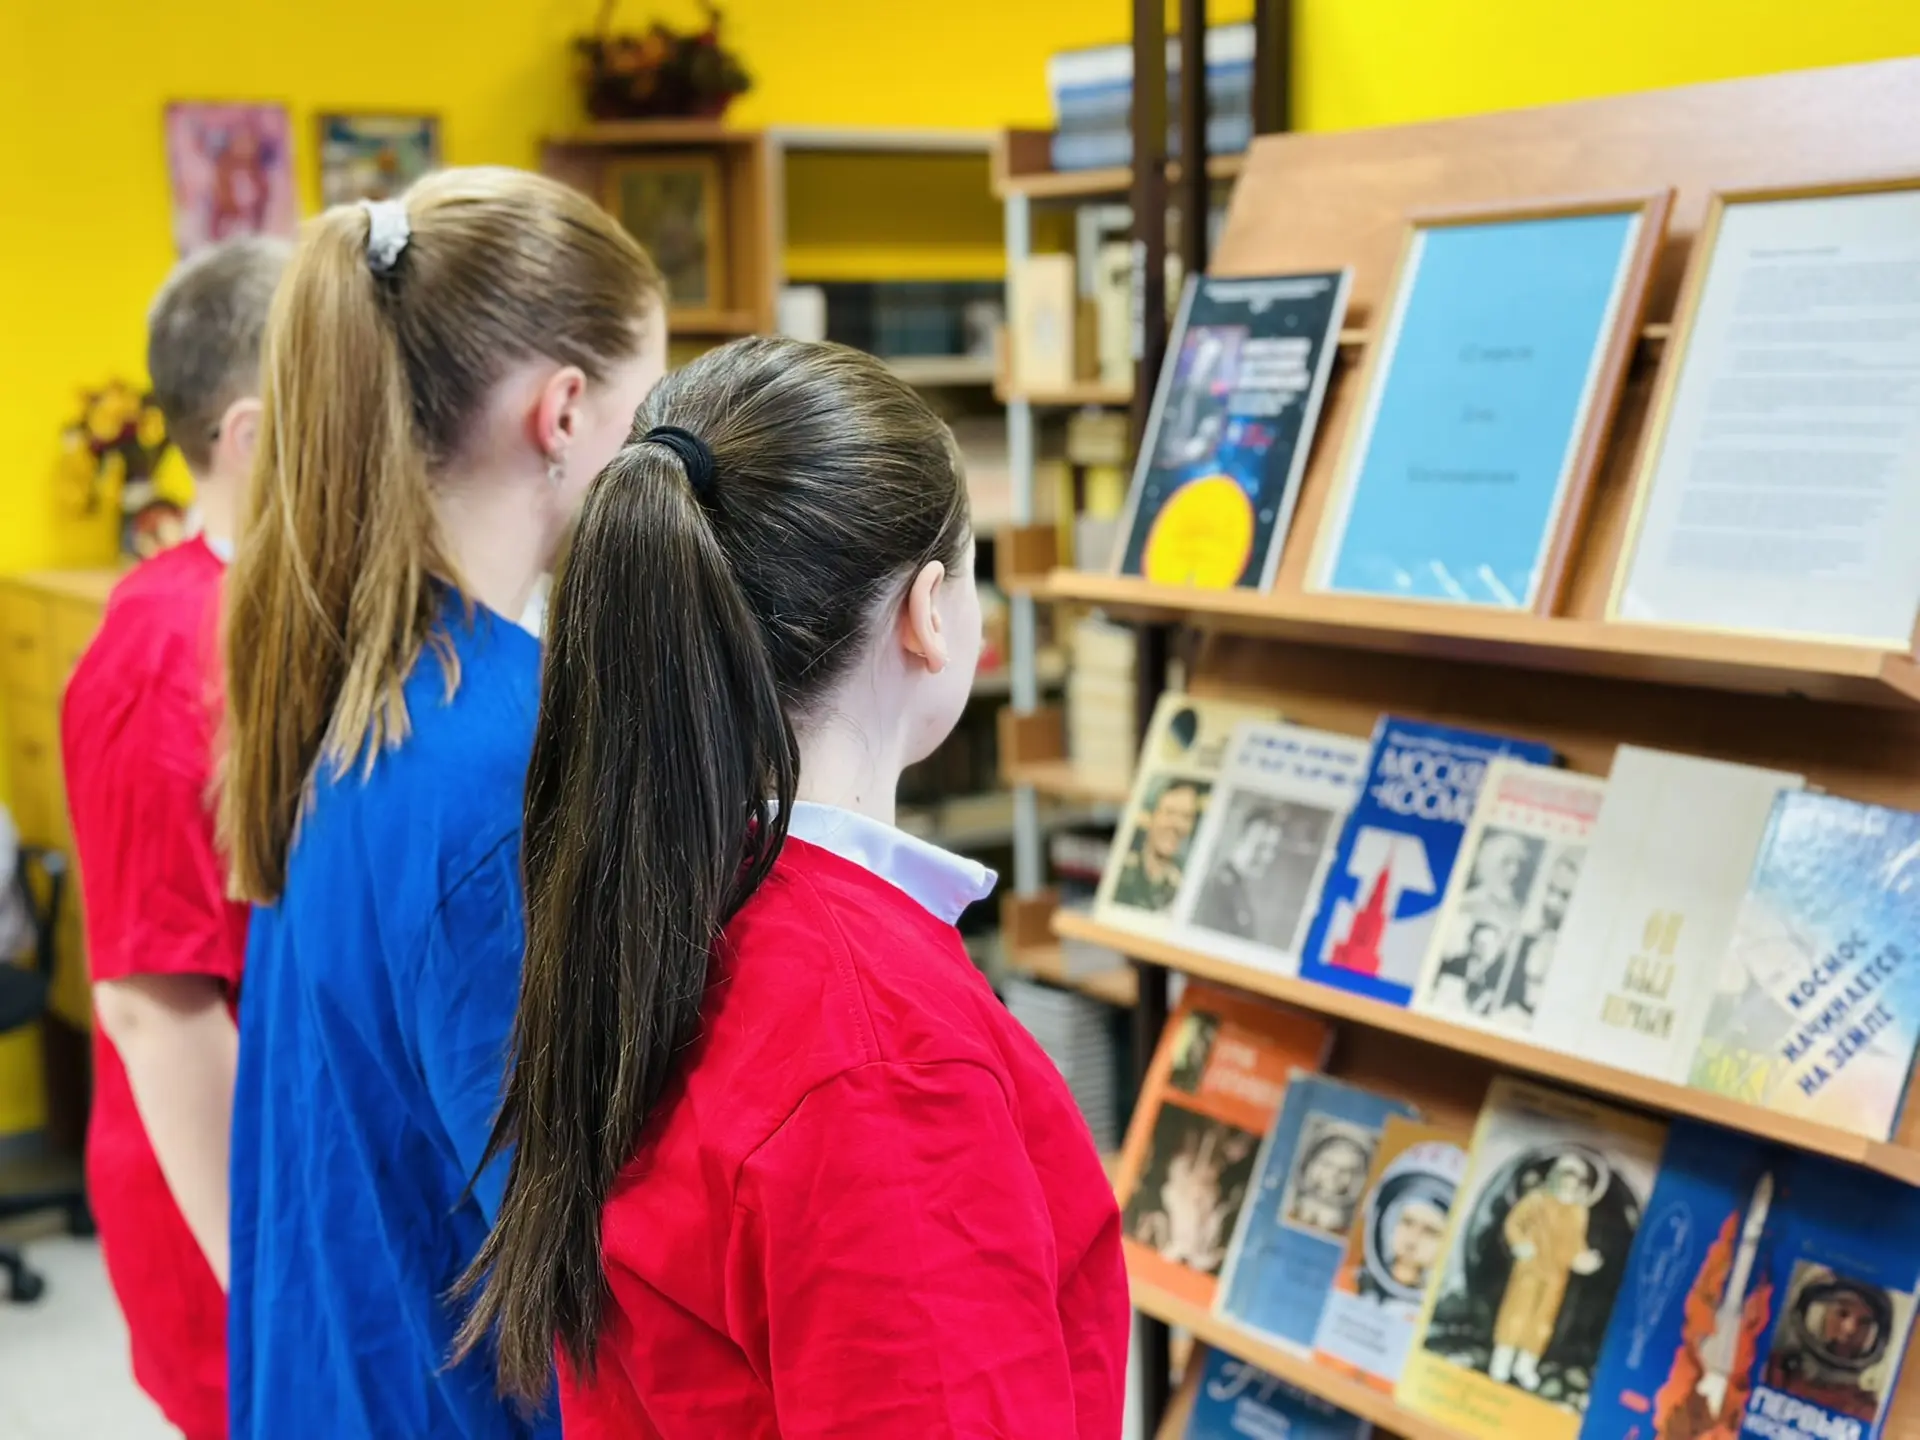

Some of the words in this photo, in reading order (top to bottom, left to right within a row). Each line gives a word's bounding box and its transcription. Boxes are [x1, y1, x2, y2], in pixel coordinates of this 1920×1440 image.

[1782, 943, 1908, 1064] НАЧИНАЕТСЯ
[1786, 930, 1870, 1010] КОСМОС
[1798, 1063, 1832, 1097] НА
[1826, 1002, 1895, 1068] ЗЕМЛЕ
